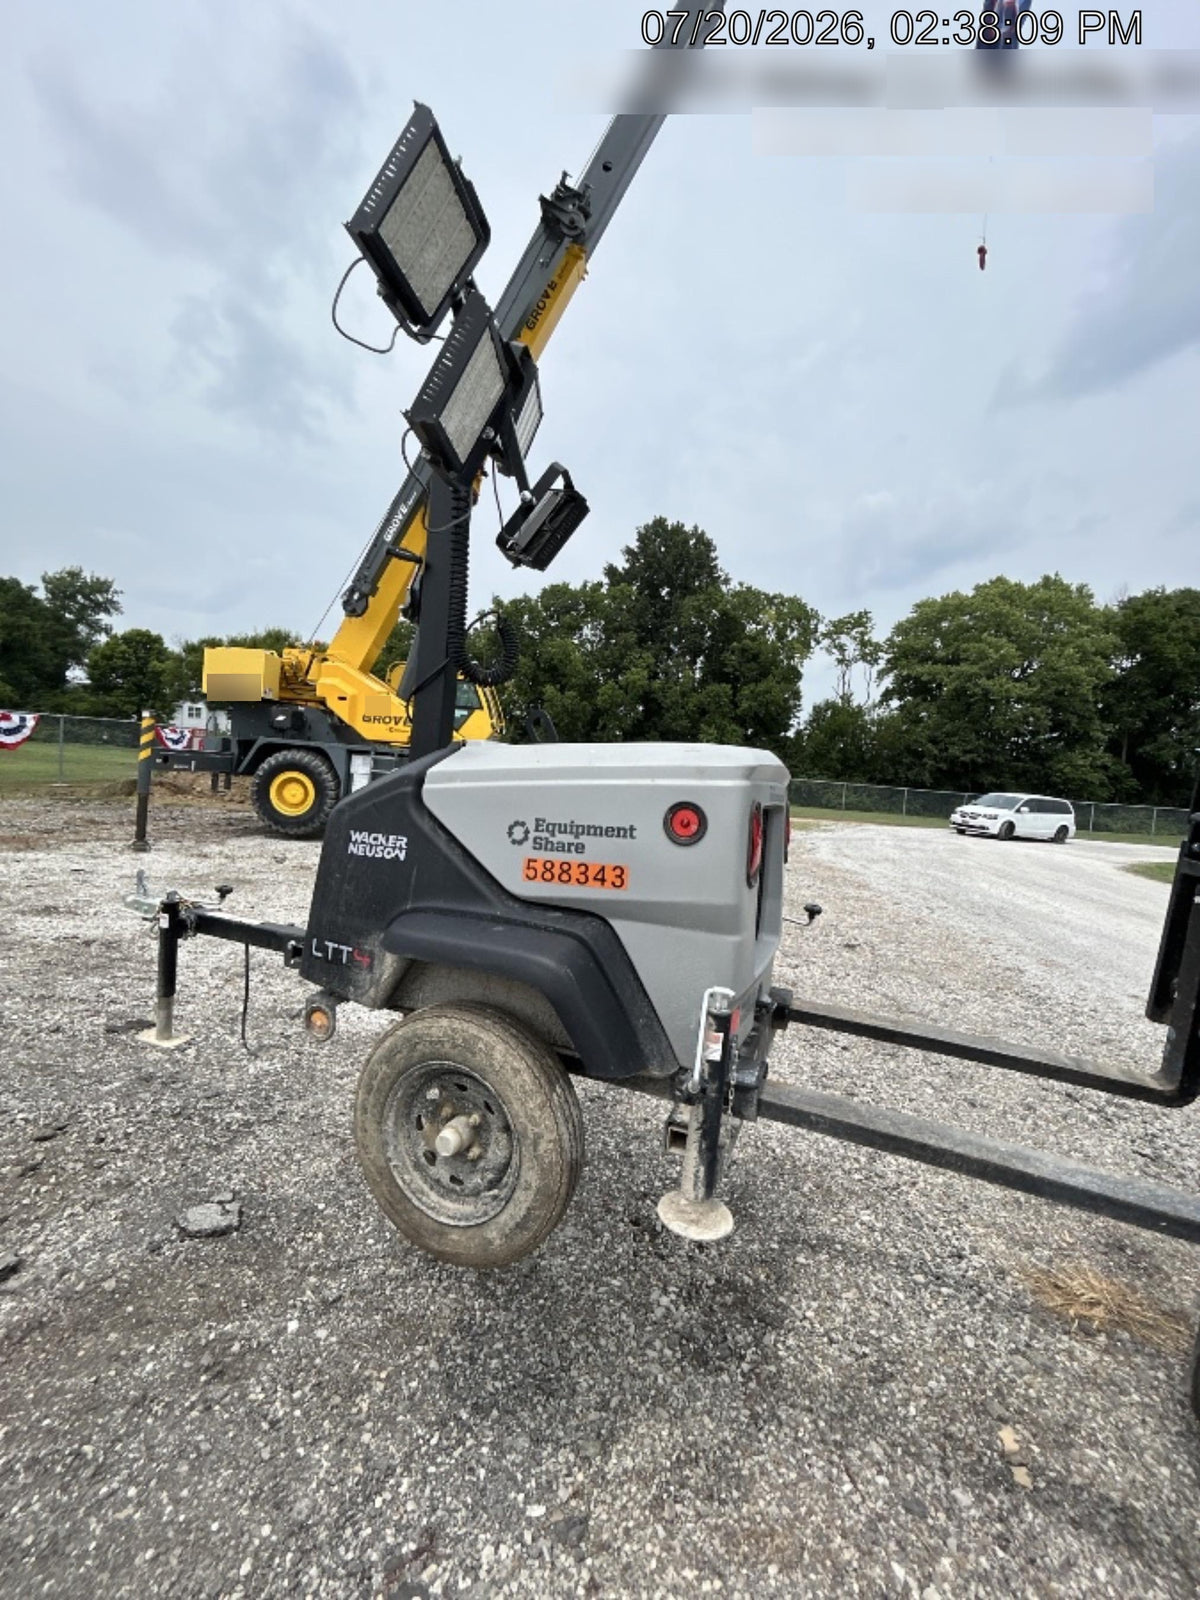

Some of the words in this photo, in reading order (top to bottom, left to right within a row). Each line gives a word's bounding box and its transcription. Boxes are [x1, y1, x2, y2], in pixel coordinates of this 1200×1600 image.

[525, 280, 558, 331] GROVE
[383, 503, 408, 542] GROVE
[350, 829, 408, 849] WACKER
[534, 818, 637, 840] Equipment
[347, 842, 406, 861] NEUSON
[532, 836, 586, 854] Share
[525, 858, 625, 888] 588343
